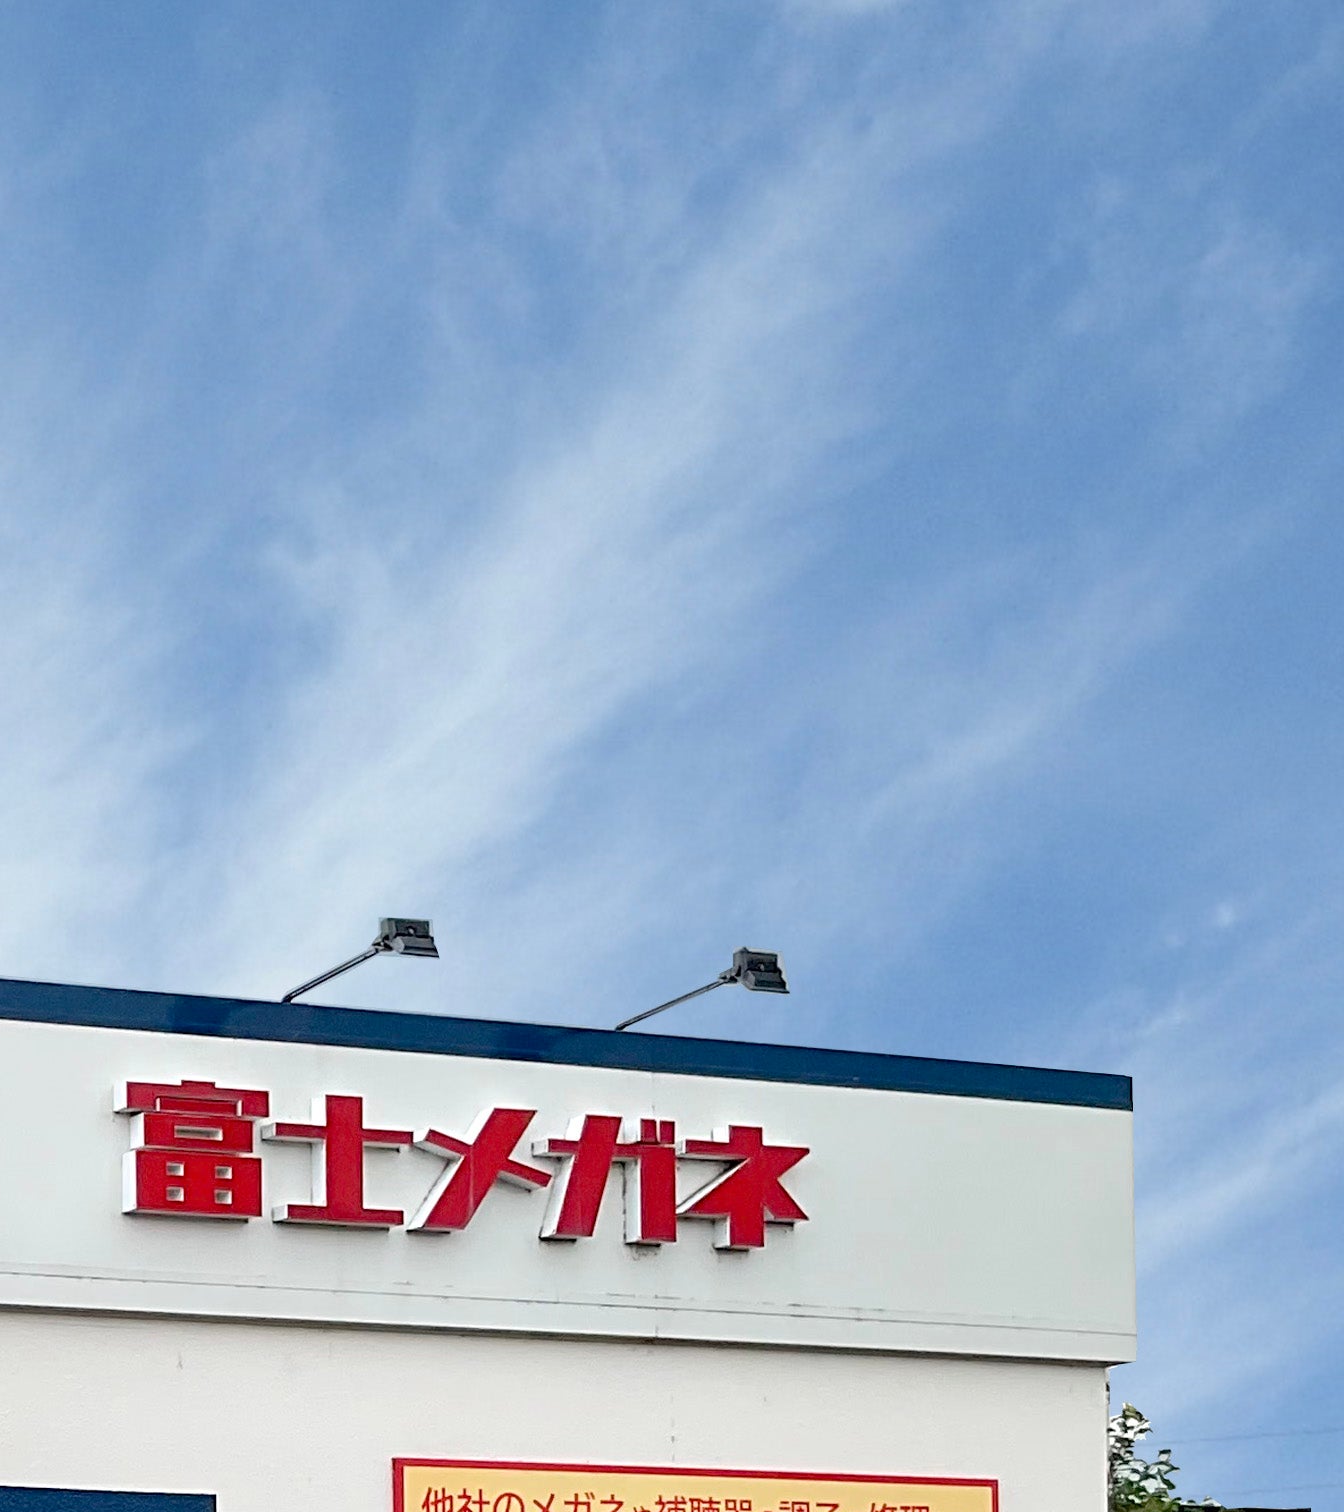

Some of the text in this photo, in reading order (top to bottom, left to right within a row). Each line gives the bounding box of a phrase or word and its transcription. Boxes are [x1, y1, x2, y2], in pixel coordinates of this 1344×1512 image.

[113, 1080, 811, 1250] 富士メガネ
